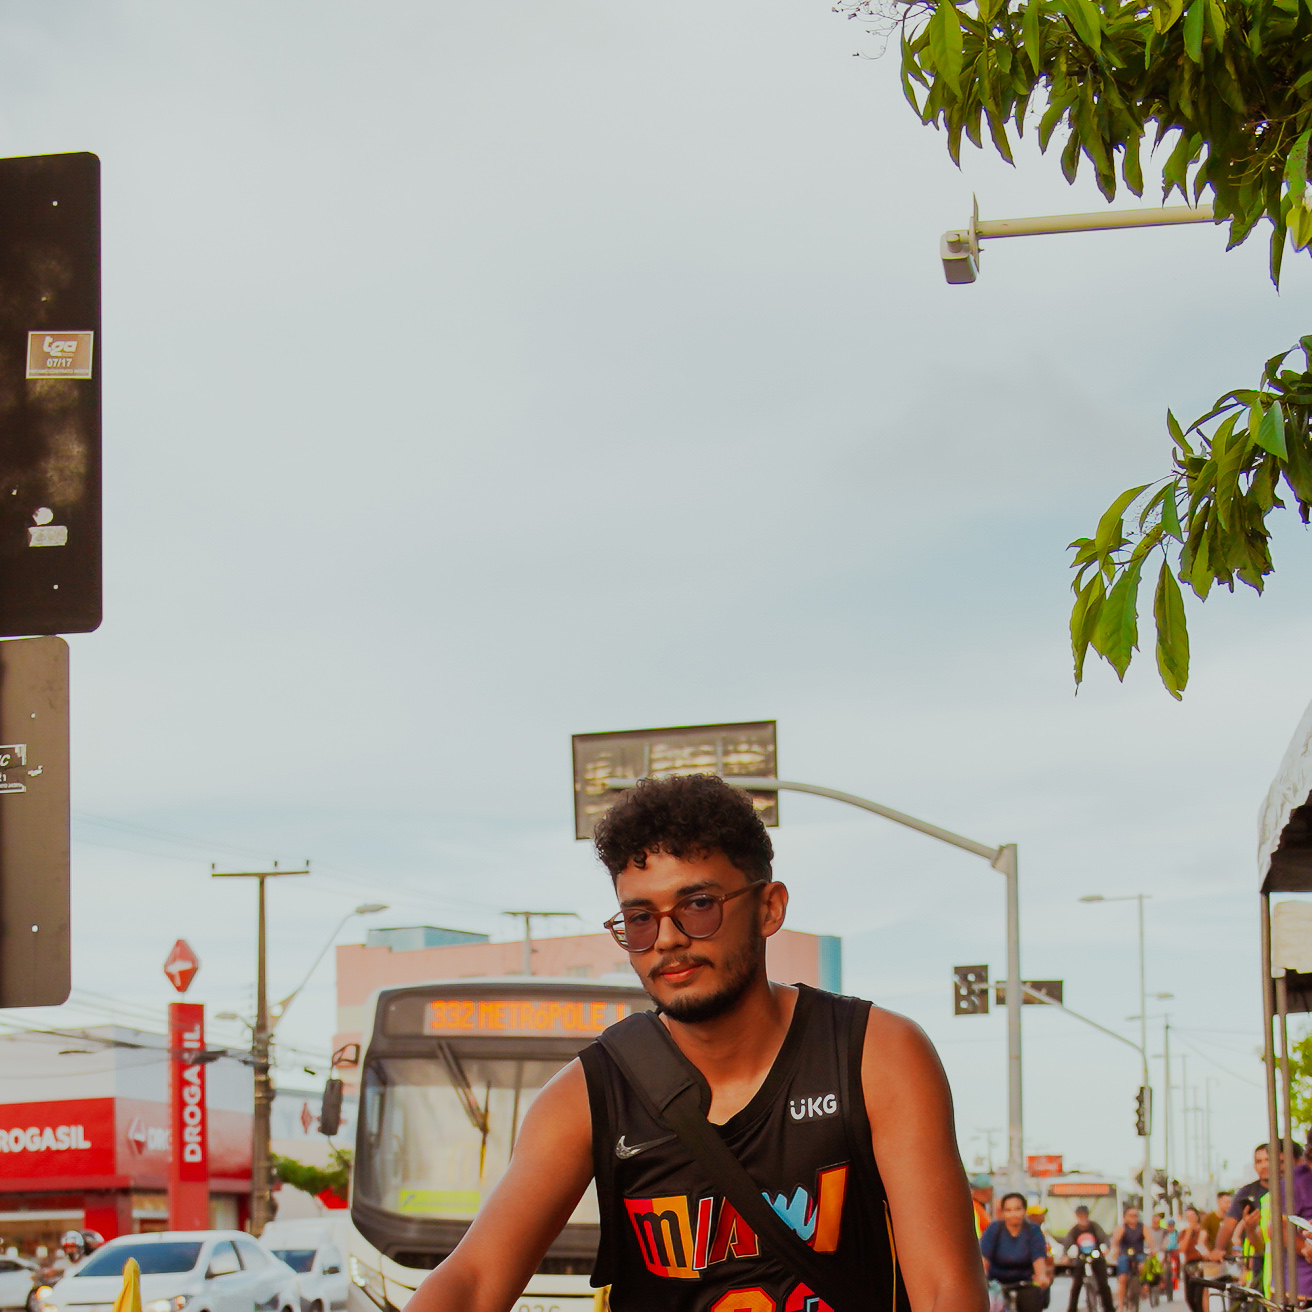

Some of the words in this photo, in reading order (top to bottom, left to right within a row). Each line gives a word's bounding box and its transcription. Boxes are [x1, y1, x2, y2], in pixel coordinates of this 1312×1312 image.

[43, 336, 78, 357] tga
[46, 358, 73, 368] 07/17
[430, 1000, 476, 1030] 332
